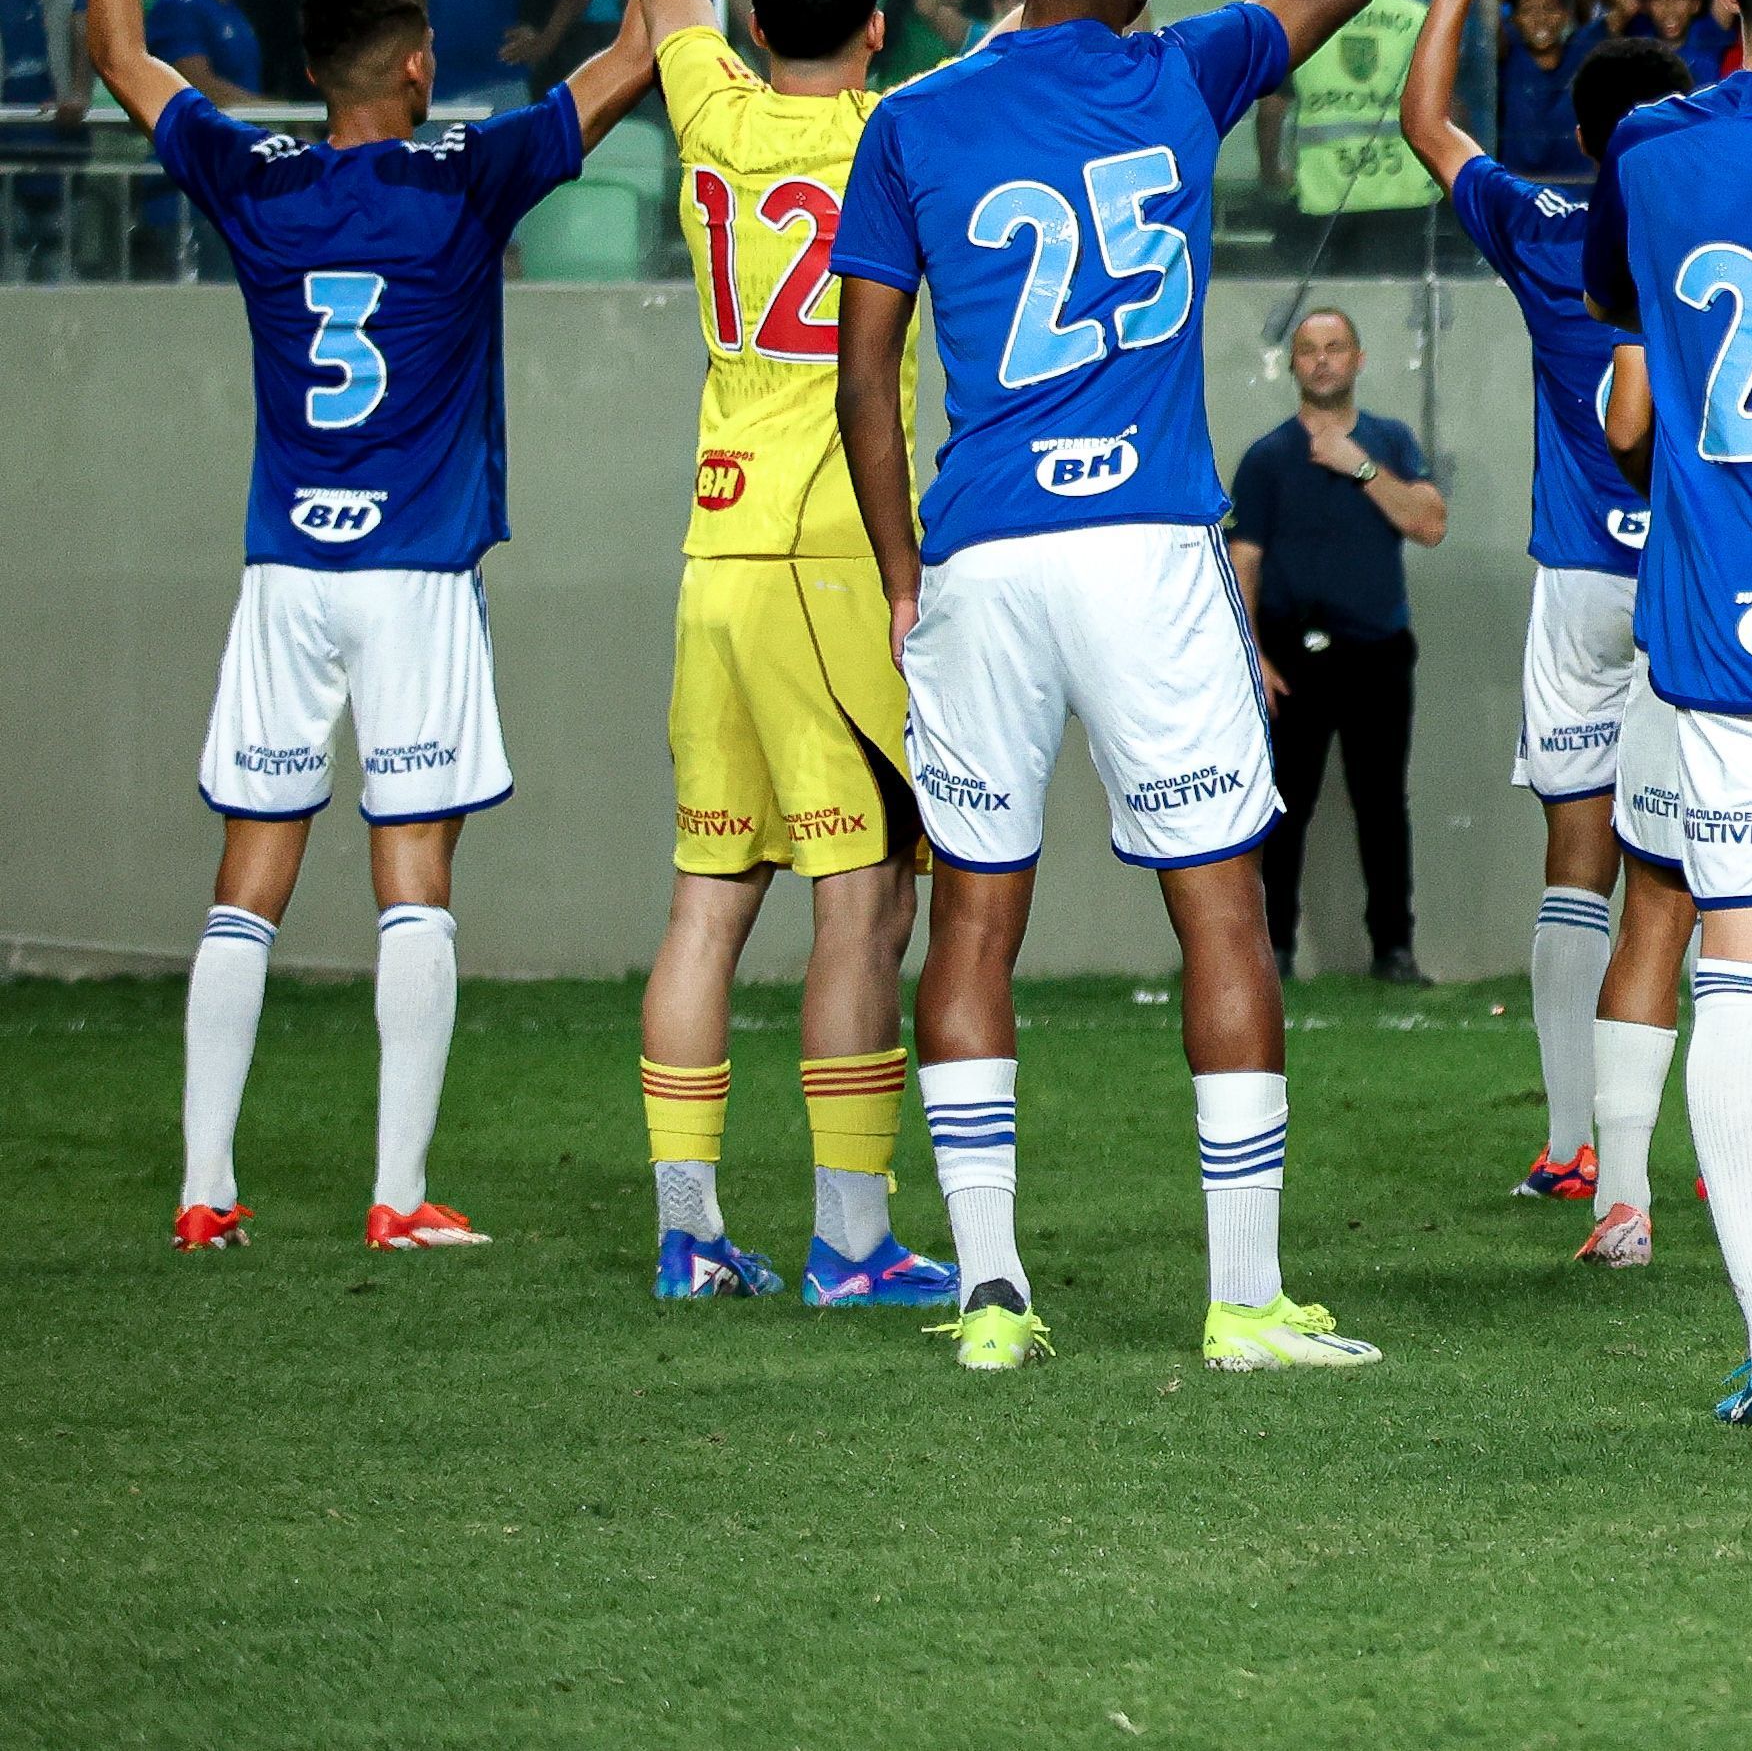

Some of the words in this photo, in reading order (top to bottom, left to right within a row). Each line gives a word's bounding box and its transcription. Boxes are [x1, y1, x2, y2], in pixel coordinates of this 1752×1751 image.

[692, 165, 840, 364] 12
[966, 144, 1194, 389] 25
[304, 271, 389, 430] 3
[1032, 424, 1138, 453] SUPERMERCADOS
[1050, 445, 1123, 486] BH
[699, 465, 741, 500] BH
[301, 504, 373, 530] BH
[235, 750, 328, 776] MULTIVIX
[365, 746, 458, 775] MULTIVIX
[924, 764, 986, 790] FACULDADE
[1126, 769, 1244, 814] MULTIVIX
[1139, 765, 1219, 792] FACULDADE
[1632, 794, 1678, 819] MULTI
